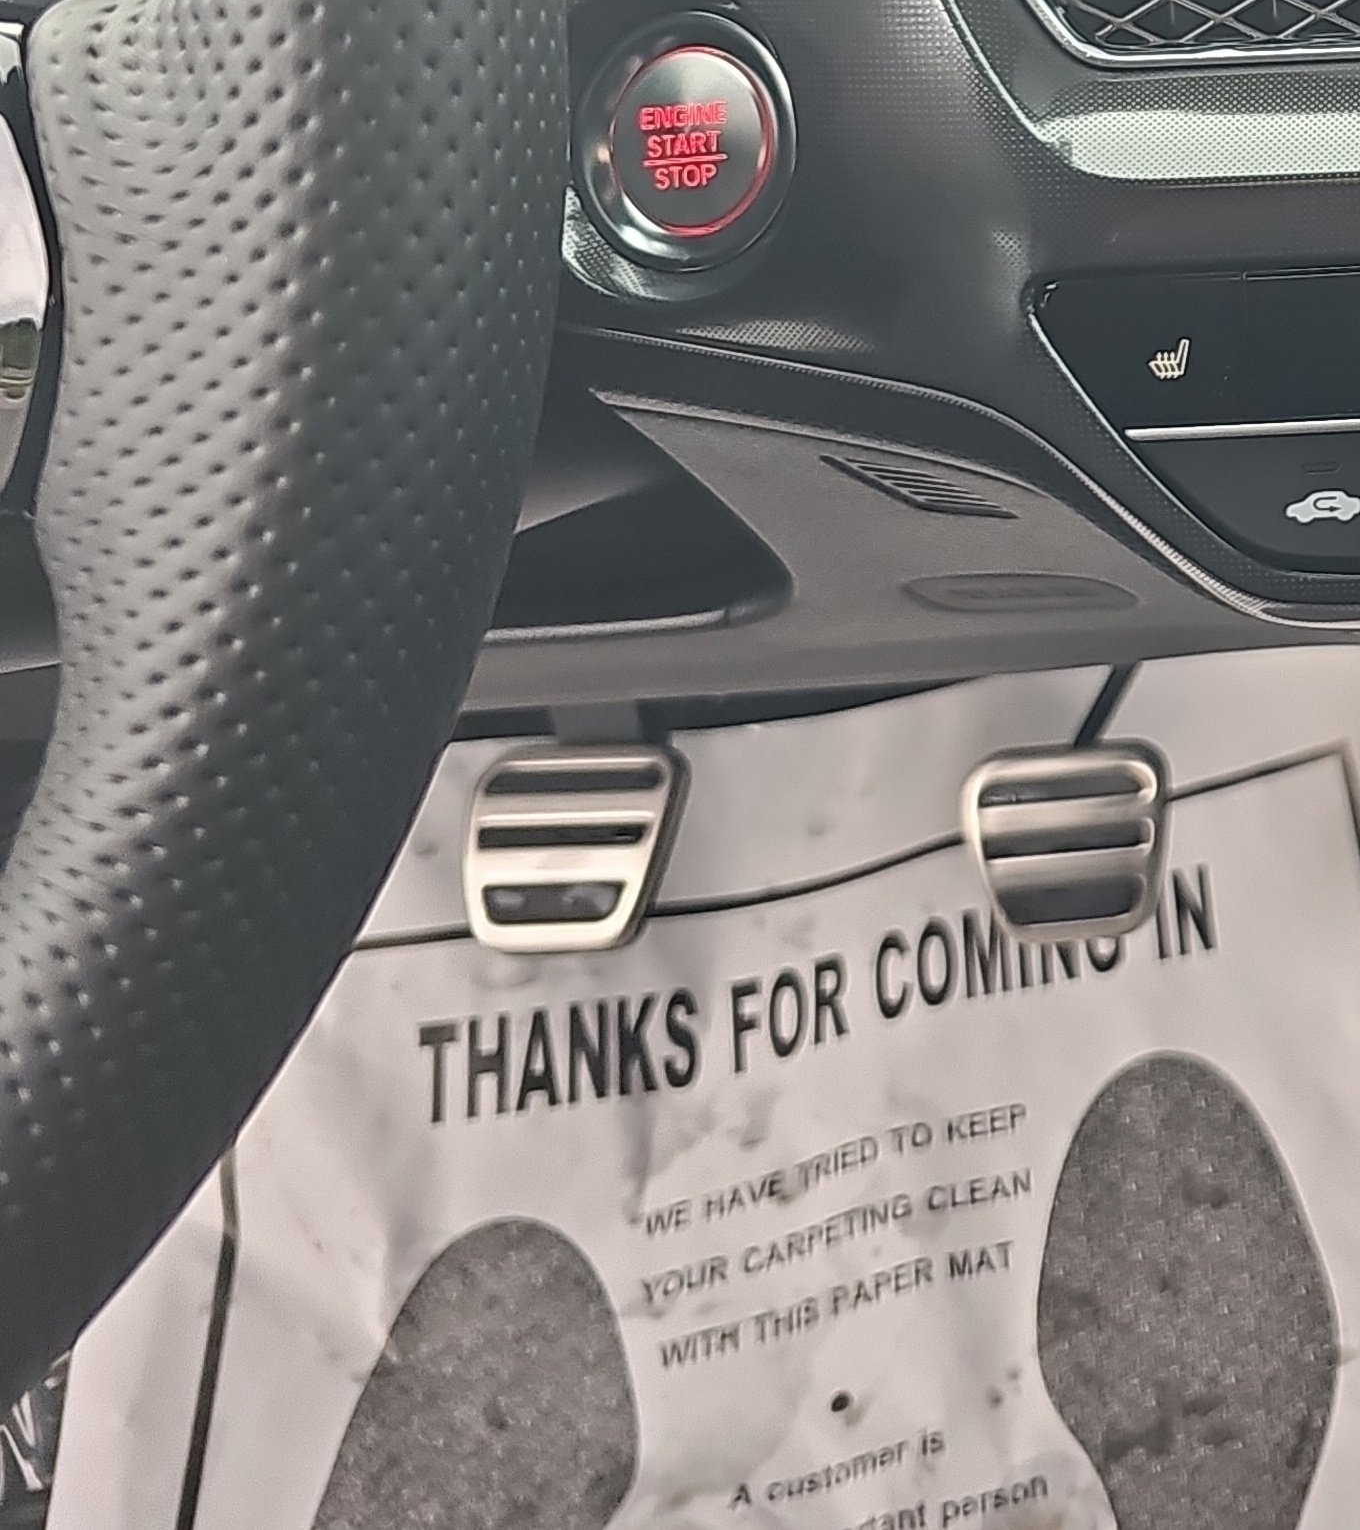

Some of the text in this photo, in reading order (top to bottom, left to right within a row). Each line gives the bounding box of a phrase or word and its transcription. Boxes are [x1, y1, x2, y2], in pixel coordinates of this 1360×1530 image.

[638, 101, 727, 131] ENGINE
[647, 131, 721, 158] START
[654, 164, 717, 191] STOP
[418, 987, 699, 1122] THANKS
[730, 952, 851, 1073] FOR
[1154, 863, 1218, 960] IN
[646, 1103, 1027, 1236] WE HAVE TRIED TO KEEP
[641, 1169, 1032, 1305] YOUR CARPETING CLEAN
[660, 1241, 1014, 1369] WITH THIS PAPER MAT
[727, 1427, 945, 1509] A customer is
[942, 1474, 1049, 1529] person
